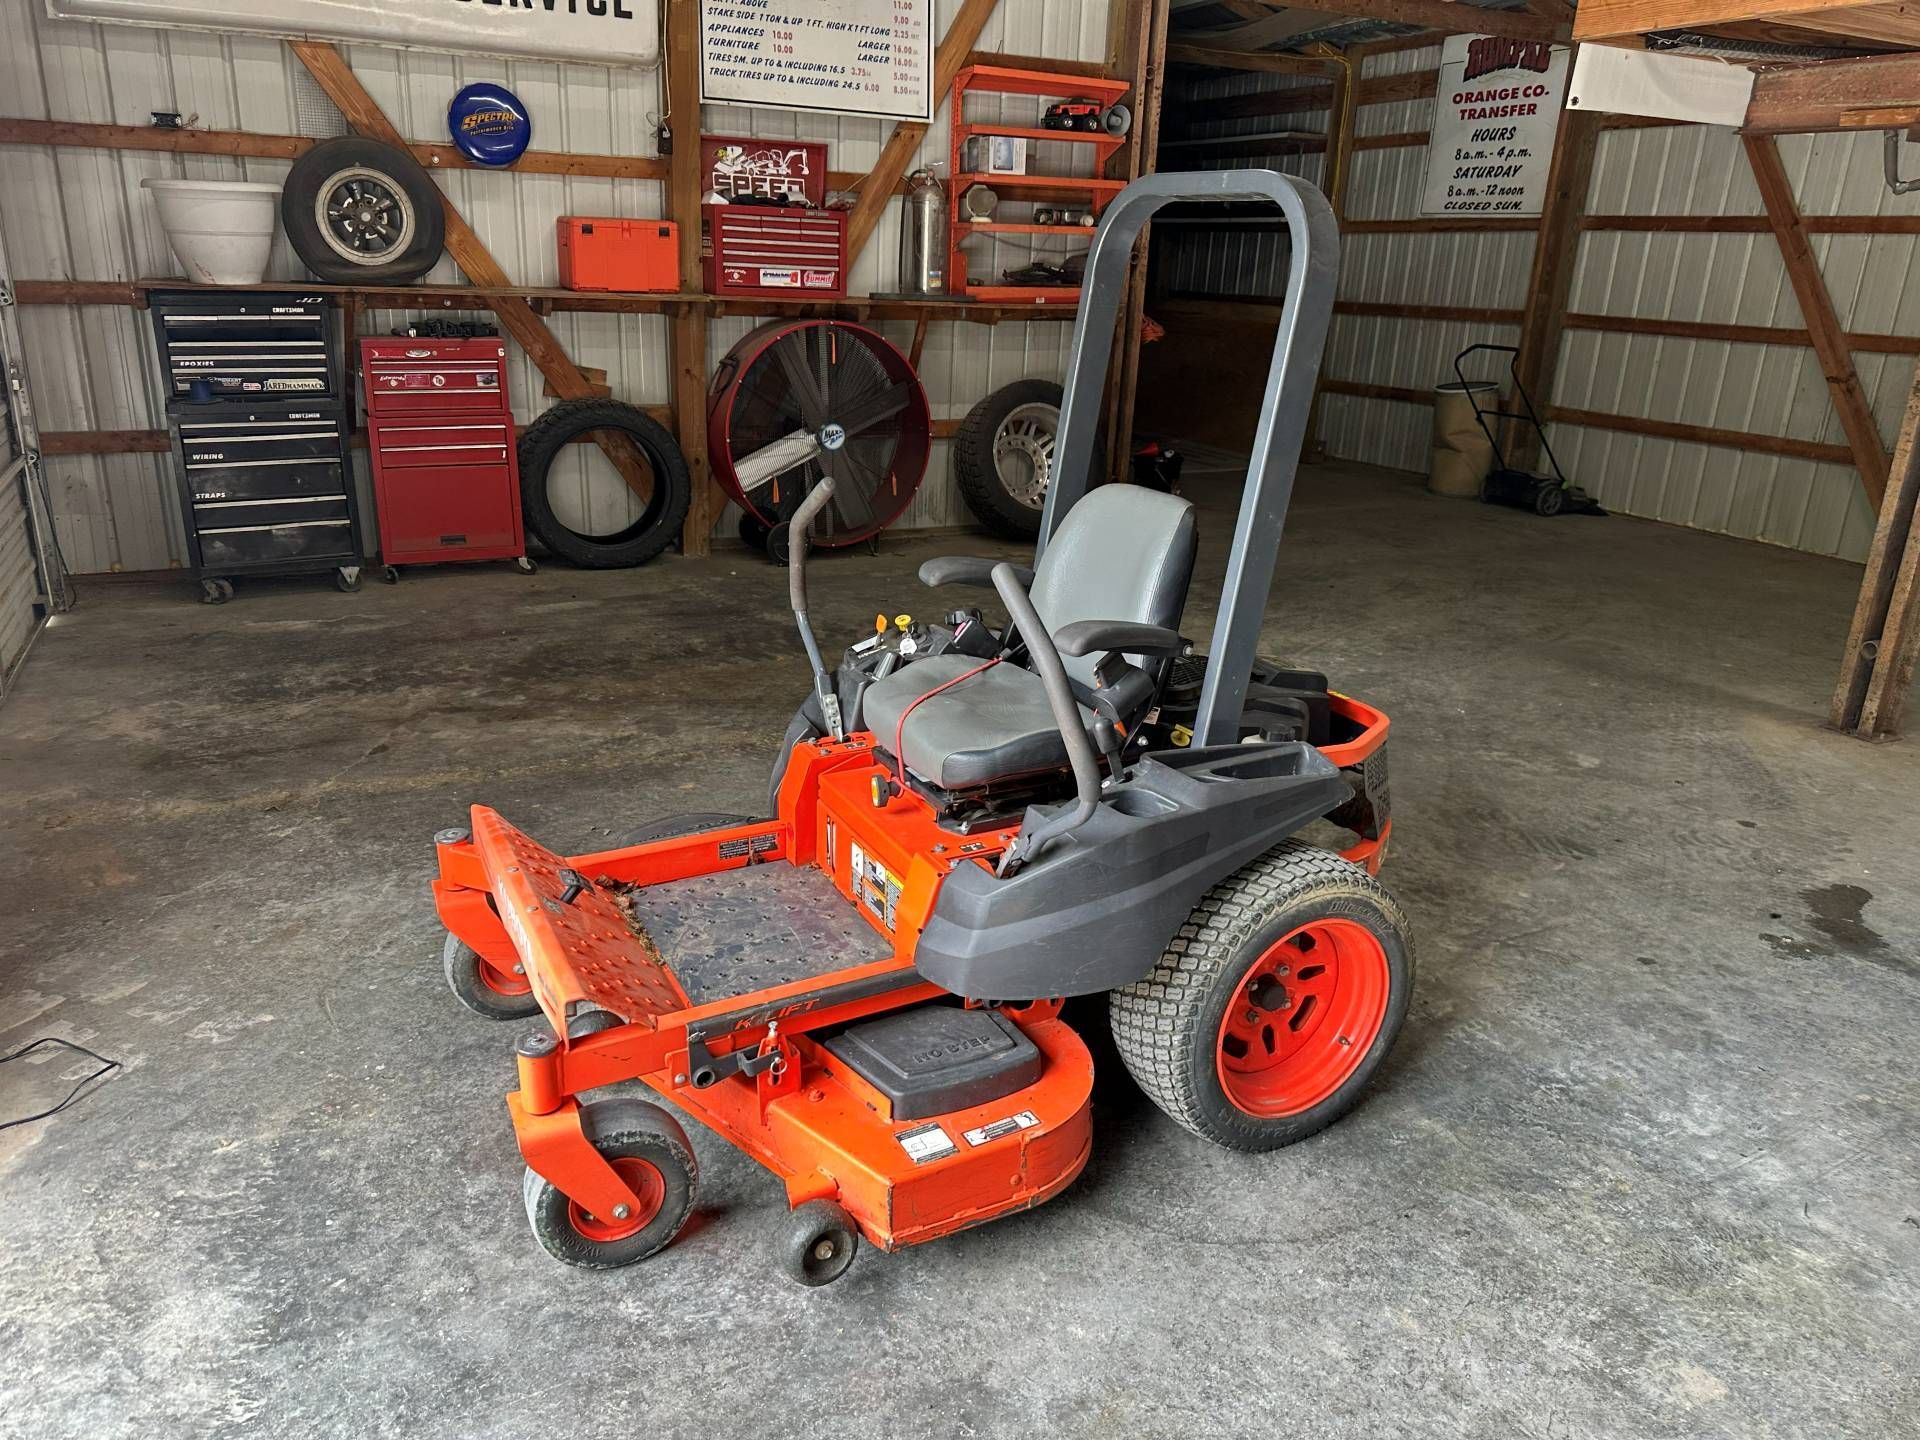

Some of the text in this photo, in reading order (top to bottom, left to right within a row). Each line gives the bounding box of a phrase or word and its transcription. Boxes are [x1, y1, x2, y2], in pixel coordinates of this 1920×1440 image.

[893, 1, 913, 10] 11.00
[707, 7, 735, 17] STAKE
[736, 10, 755, 20] SIDE
[765, 14, 782, 23] TON
[791, 17, 803, 25] UP
[812, 19, 824, 28] FT.
[826, 21, 846, 31] HIGH
[847, 24, 853, 32] X
[859, 25, 870, 34] FT
[870, 27, 891, 36] LONG
[894, 30, 909, 39] 2.25
[894, 15, 909, 25] 9.00
[708, 23, 793, 40] APPLIANCES 10.00
[708, 37, 793, 54] FURNITURE 10.00
[857, 40, 890, 51] LARGER
[708, 52, 732, 62] TIRES
[733, 55, 748, 64] SM.
[751, 57, 763, 65] UP
[764, 58, 775, 67] TO
[784, 60, 827, 72] INCLUDING
[829, 65, 845, 74] 16.5
[857, 53, 890, 64] LARGER
[709, 67, 737, 77] TRUCK
[738, 70, 762, 80] TIRES
[763, 72, 775, 81] UP
[776, 74, 787, 82] TO
[788, 75, 795, 83] &
[796, 76, 839, 88] INCLUDING
[841, 81, 861, 90] 24.5
[1452, 84, 1550, 105] ORANGE CO.
[1459, 103, 1538, 121] TRANSFER
[1471, 126, 1517, 142] HOURS
[1453, 164, 1523, 180] SATURDAY
[1499, 186, 1525, 196] noon
[1444, 201, 1522, 211] CLOSED SUN.
[912, 1035, 991, 1064] NO STEP
